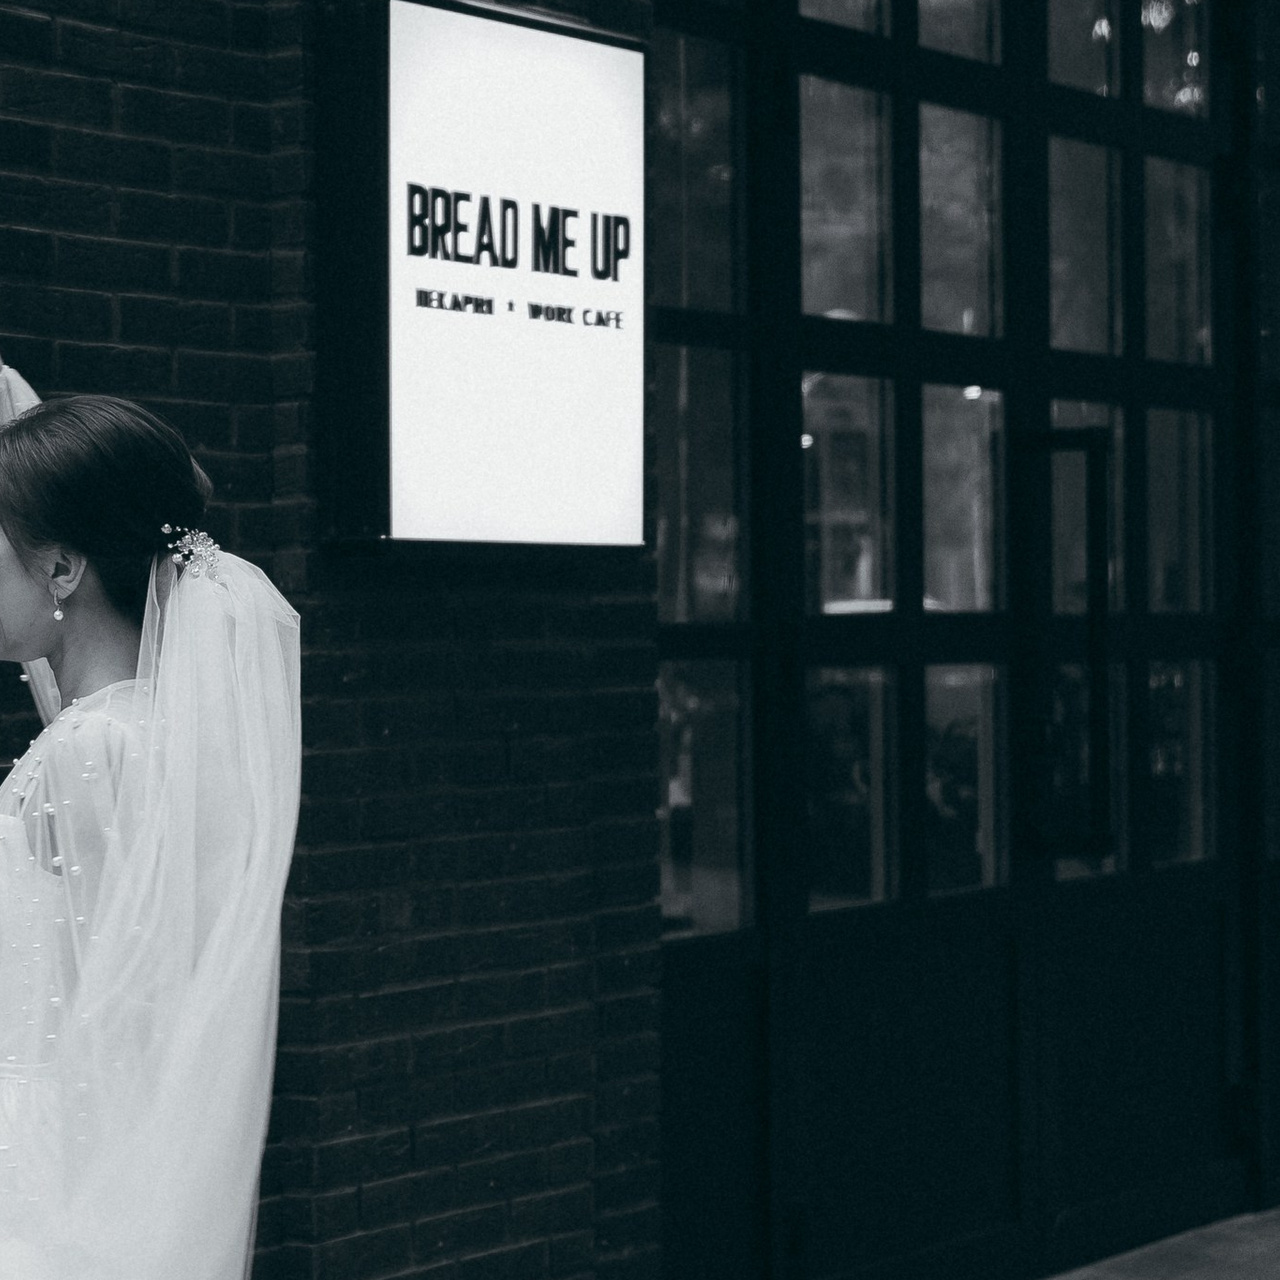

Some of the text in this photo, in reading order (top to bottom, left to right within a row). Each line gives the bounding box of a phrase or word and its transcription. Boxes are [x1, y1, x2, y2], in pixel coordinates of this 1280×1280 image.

[406, 182, 631, 283] BREAD ME UP
[527, 301, 574, 325] WORK
[582, 308, 624, 330] CAFE
